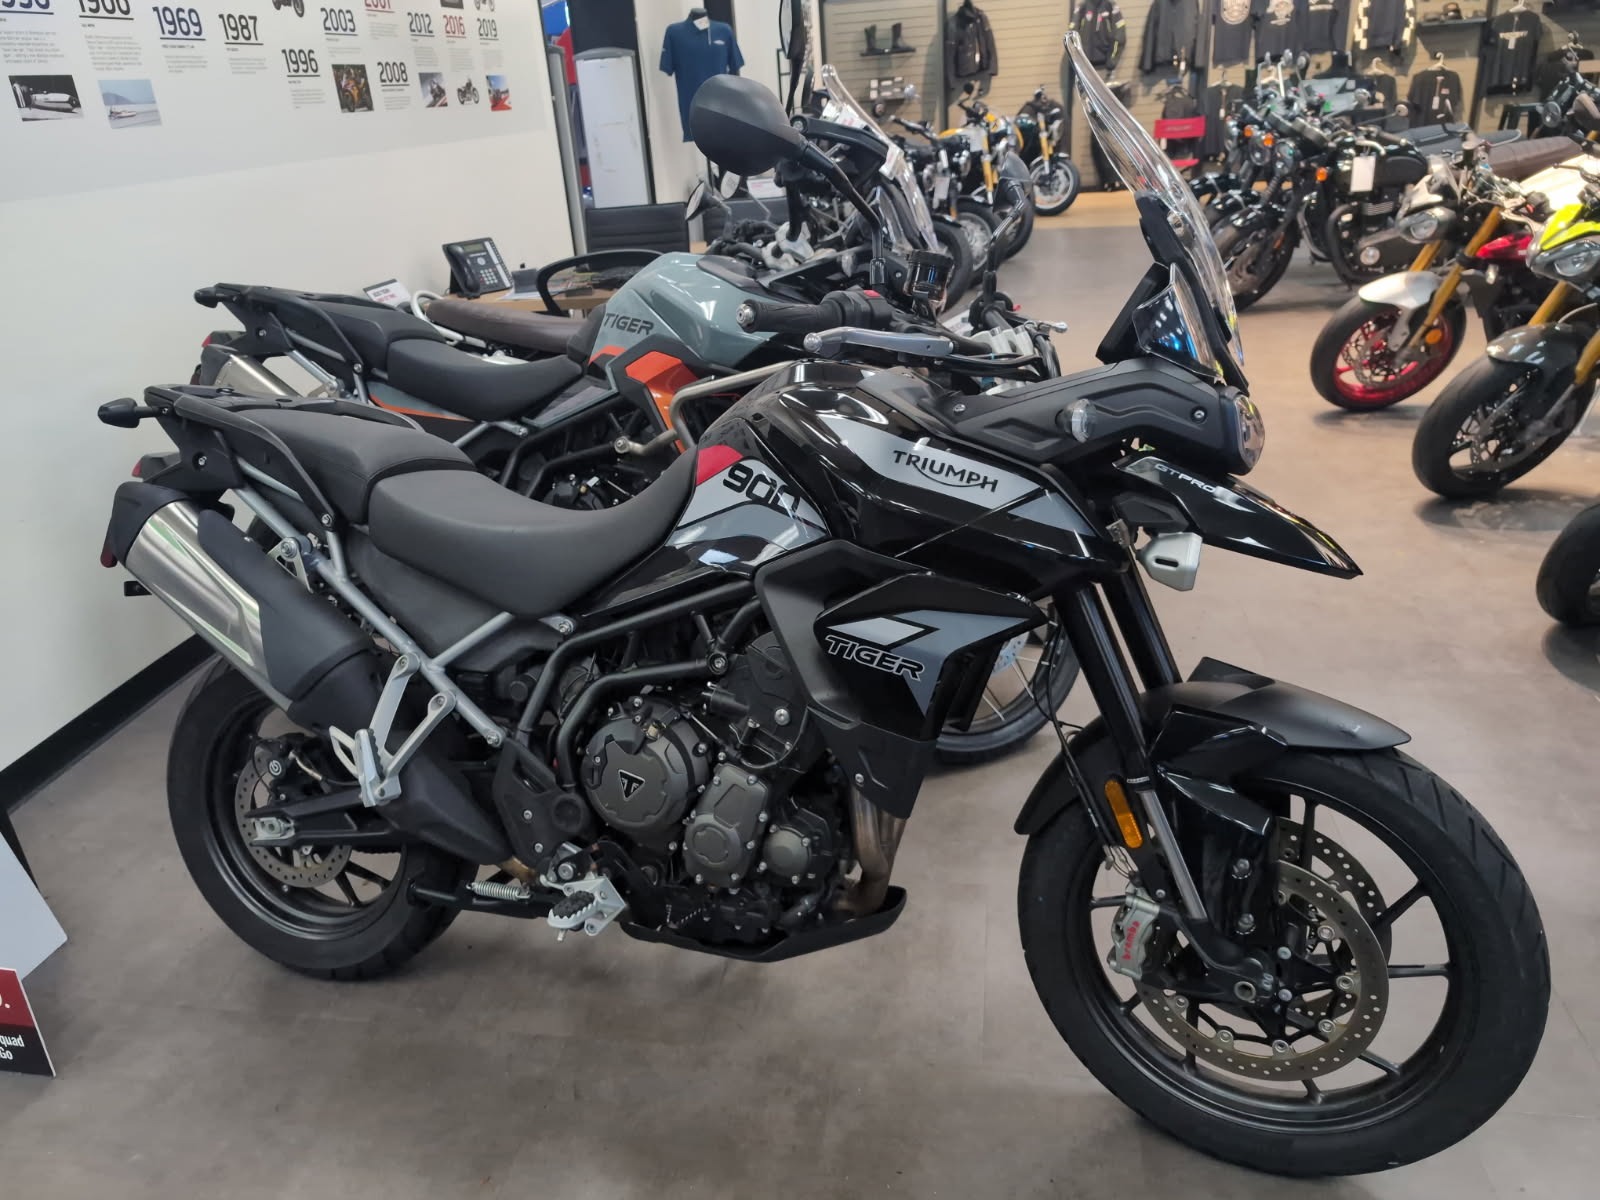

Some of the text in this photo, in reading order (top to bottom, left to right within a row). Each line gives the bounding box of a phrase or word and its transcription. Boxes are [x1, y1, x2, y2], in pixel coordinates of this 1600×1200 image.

[152, 6, 203, 37] 1969
[218, 13, 259, 42] 1987
[321, 8, 356, 33] 2003
[407, 12, 433, 34] 2012
[443, 15, 466, 36] 2016
[477, 18, 498, 38] 2019
[281, 48, 319, 74] 1996
[377, 62, 408, 83] 2008
[604, 313, 654, 336] TIGER
[893, 450, 999, 493] TRIUMPH
[722, 462, 801, 514] 900
[825, 634, 925, 682] TIGER
